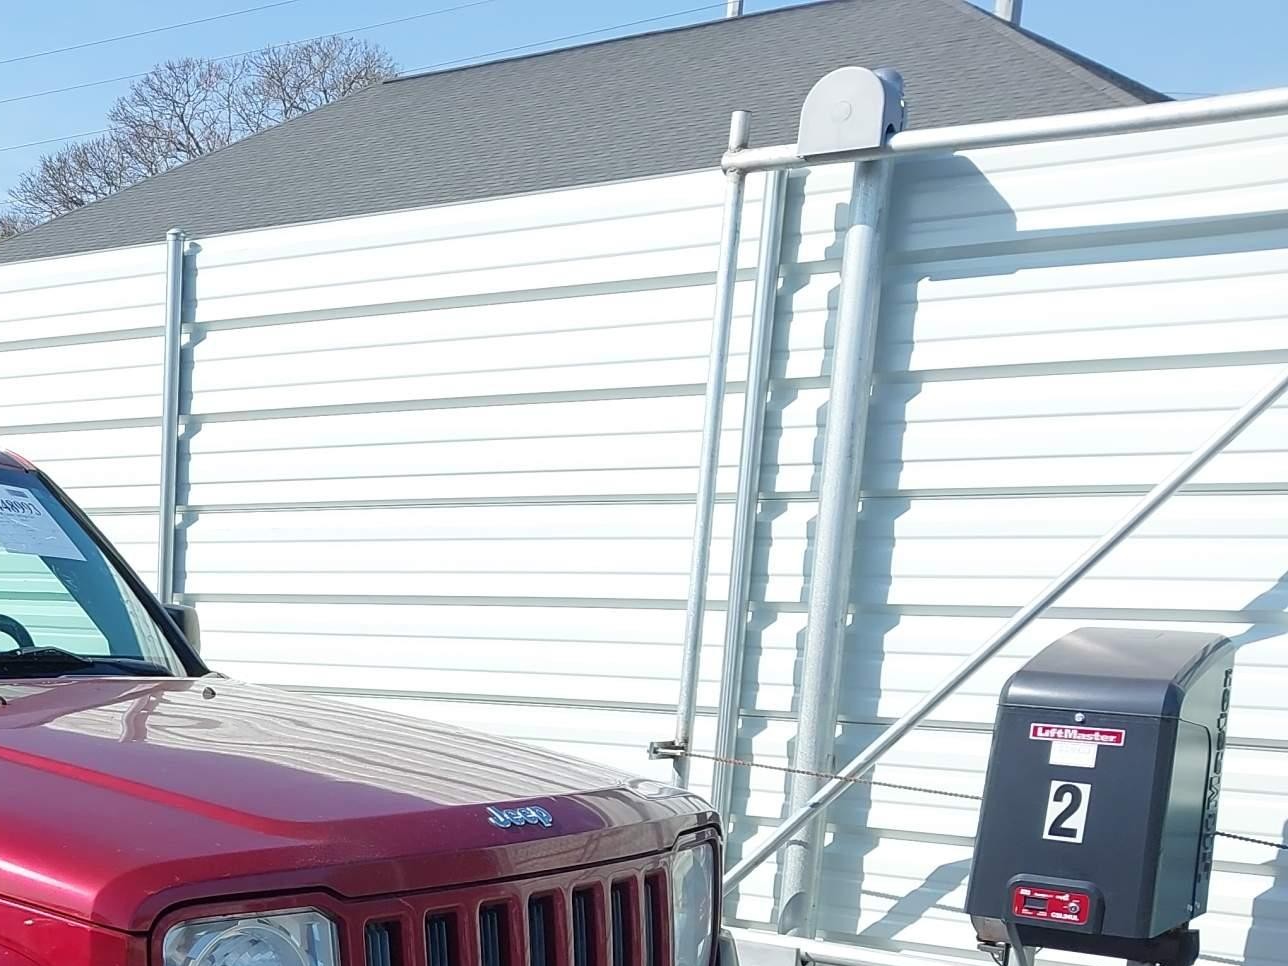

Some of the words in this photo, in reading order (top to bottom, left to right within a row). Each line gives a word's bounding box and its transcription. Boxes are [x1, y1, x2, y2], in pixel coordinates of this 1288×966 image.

[1037, 726, 1117, 742] LiftMaster
[486, 805, 553, 828] Jeep
[1048, 783, 1083, 839] 2
